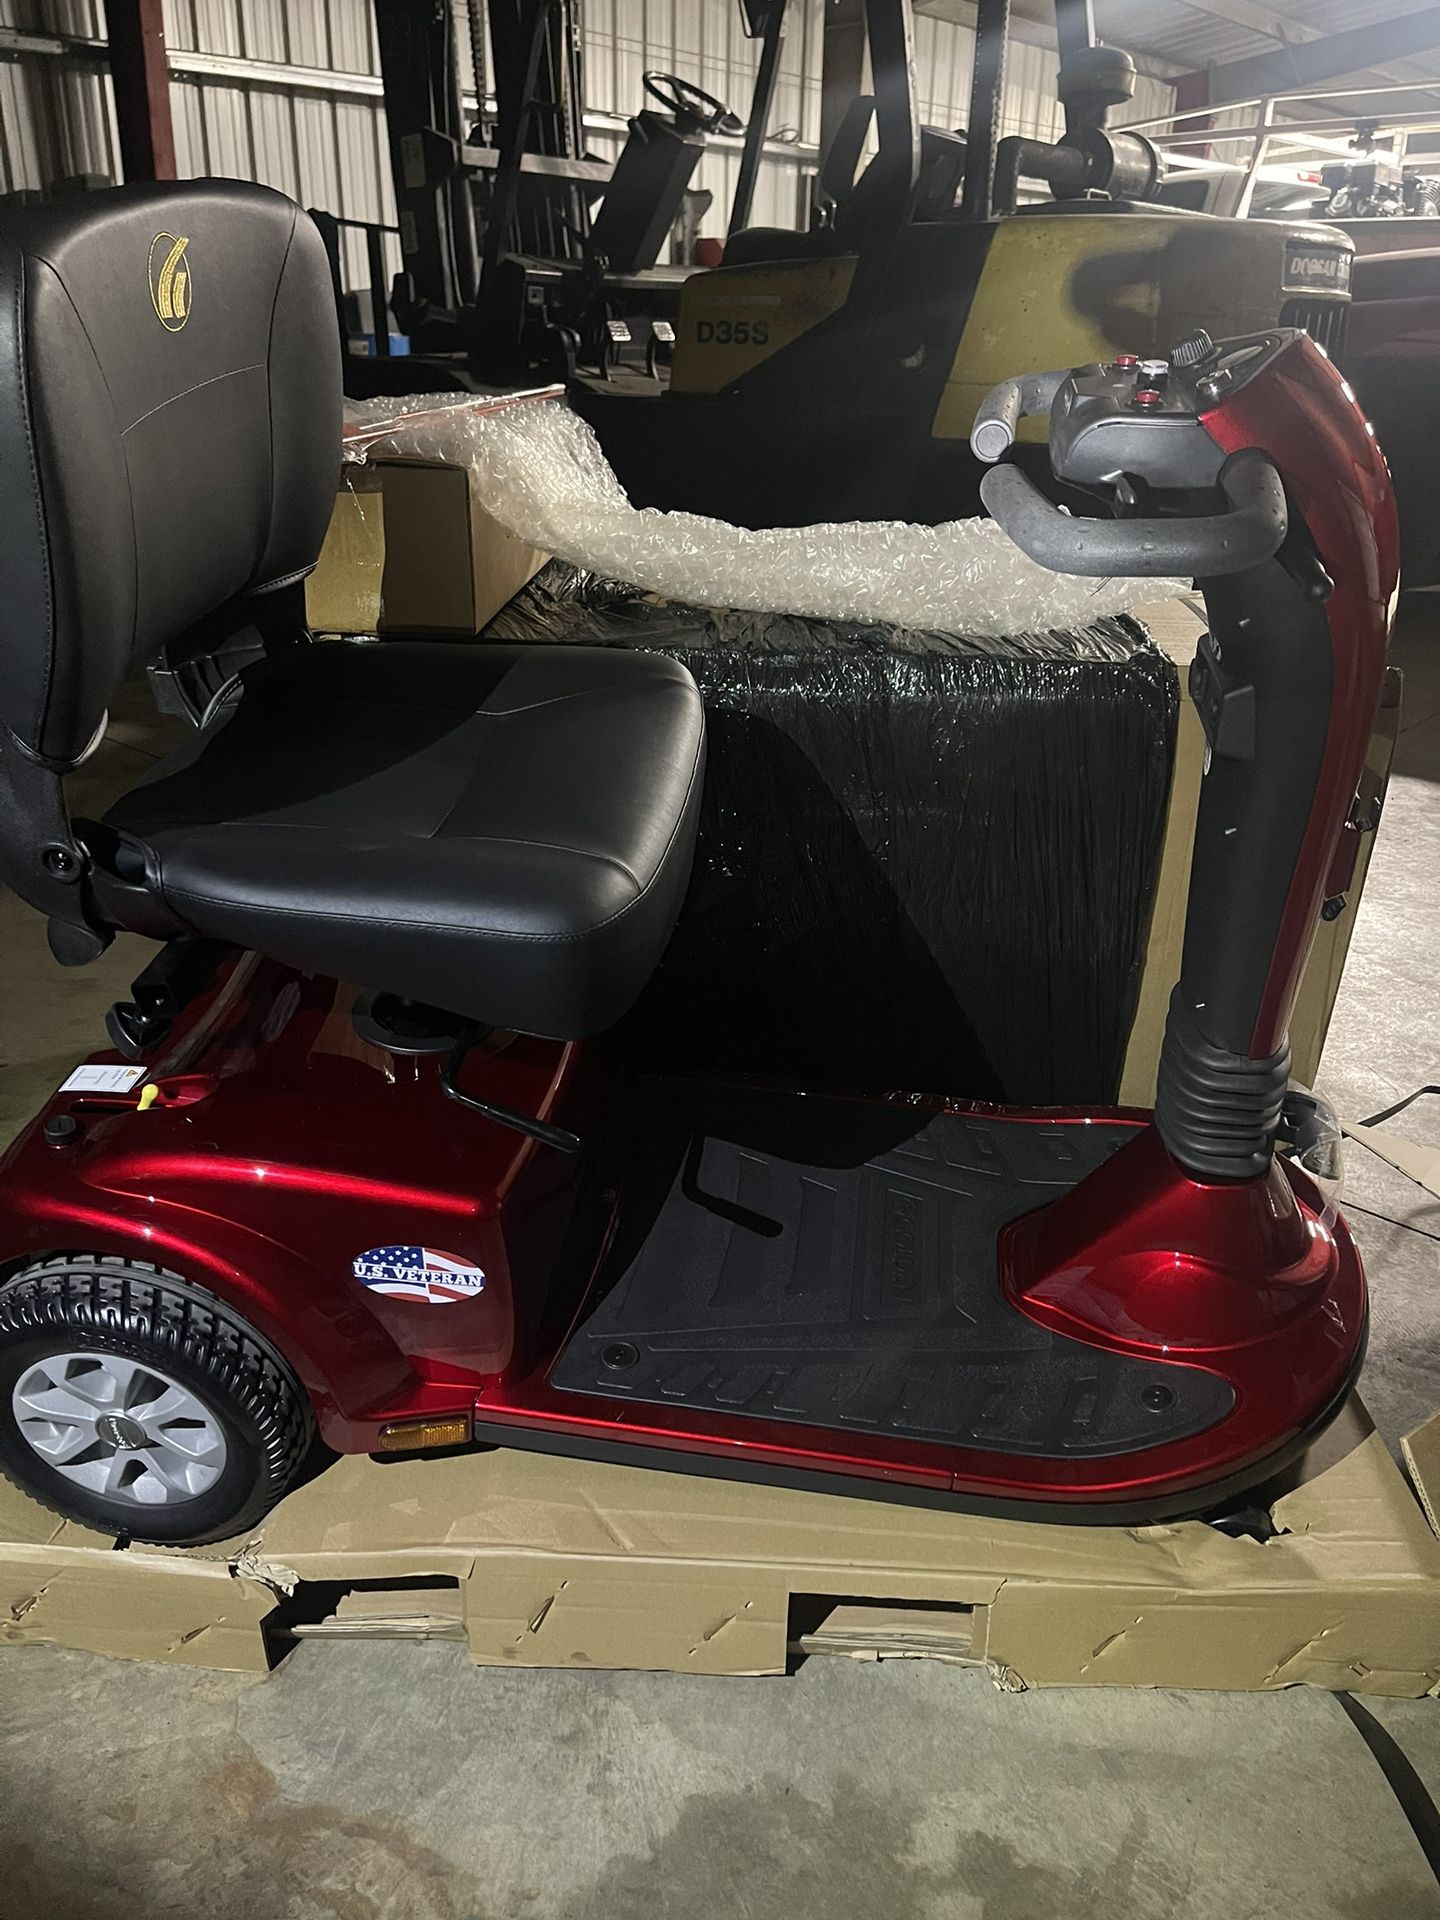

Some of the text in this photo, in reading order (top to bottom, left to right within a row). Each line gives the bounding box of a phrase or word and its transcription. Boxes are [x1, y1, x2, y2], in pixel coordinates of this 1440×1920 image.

[696, 319, 769, 345] D35S
[353, 1263, 482, 1287] U.S. VETERAN
